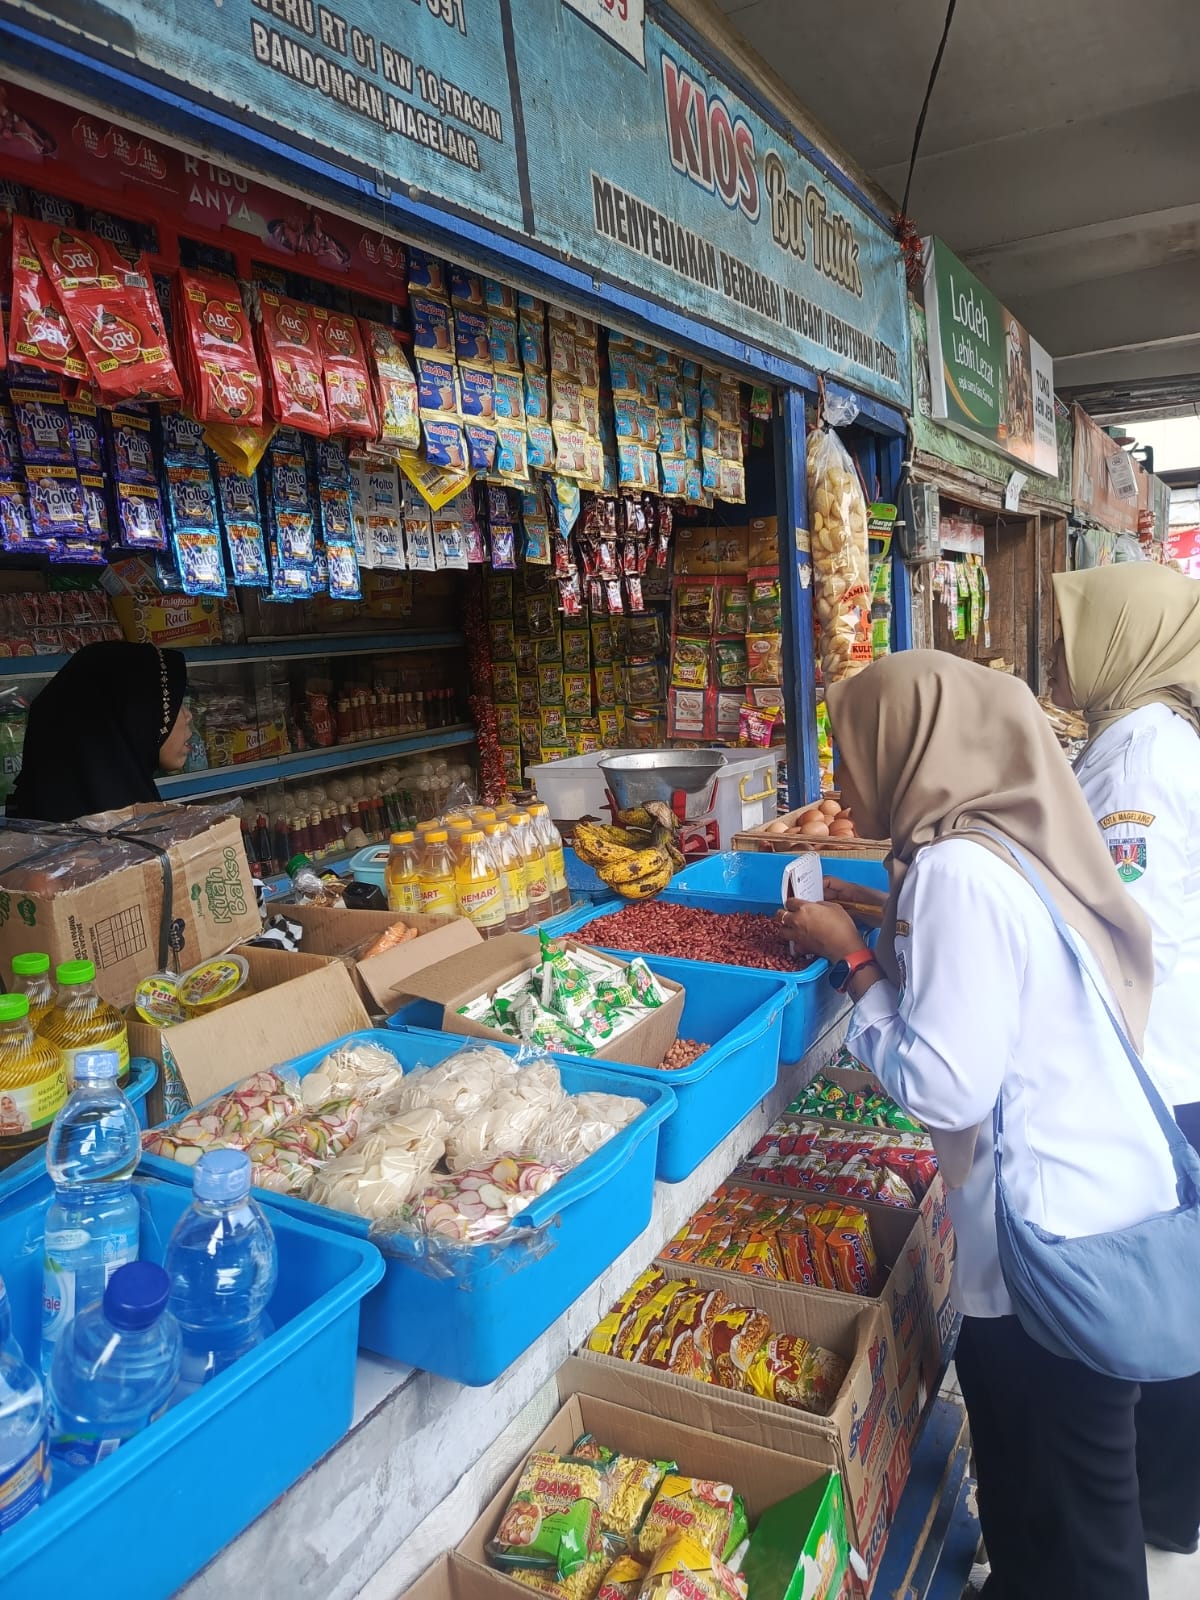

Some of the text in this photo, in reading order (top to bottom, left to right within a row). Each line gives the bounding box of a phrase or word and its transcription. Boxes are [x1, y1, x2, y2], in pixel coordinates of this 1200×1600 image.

[319, 7, 348, 56] RT
[351, 26, 378, 75] 01
[380, 41, 414, 94] RW
[661, 49, 760, 225] KIOS
[208, 160, 249, 193] IBU
[764, 149, 807, 262] Bu
[91, 217, 129, 242] Molto
[62, 252, 94, 269] ABC
[590, 170, 720, 293] MENYEDIAKAN
[719, 242, 782, 325] BERBAGAI
[783, 286, 824, 347] MACAM
[824, 310, 876, 373] KEBUTUHAN
[949, 274, 991, 347] Lodeh
[207, 313, 236, 329] ABC
[281, 314, 304, 333] ABC
[102, 331, 135, 350] ABC
[329, 327, 351, 343] ABC
[952, 332, 995, 388] Lebih Lezat
[222, 385, 248, 401] ABC
[292, 383, 316, 397] ABC
[338, 393, 362, 406] ABC
[22, 409, 65, 431] Molto
[167, 416, 201, 437] Molto
[73, 425, 97, 440] olto
[119, 432, 151, 453] Molto
[319, 444, 345, 461] Molto
[278, 468, 306, 485] Molto
[369, 476, 394, 491] Molto
[36, 487, 78, 505] Molto
[176, 484, 209, 501] Molto
[225, 479, 254, 496] Molto
[326, 503, 350, 518] Molto
[373, 531, 398, 545] Molto
[411, 535, 429, 547] Molto
[234, 543, 260, 558] Molto
[186, 551, 218, 569] Molto
[164, 610, 194, 627] Racik
[1102, 812, 1152, 827] KOTA MAGELANG
[223, 846, 248, 916] Bakso
[207, 867, 232, 924] Kuah
[461, 885, 498, 905] HEMART
[533, 1477, 582, 1498] DARA
[651, 1500, 695, 1527] DARA
